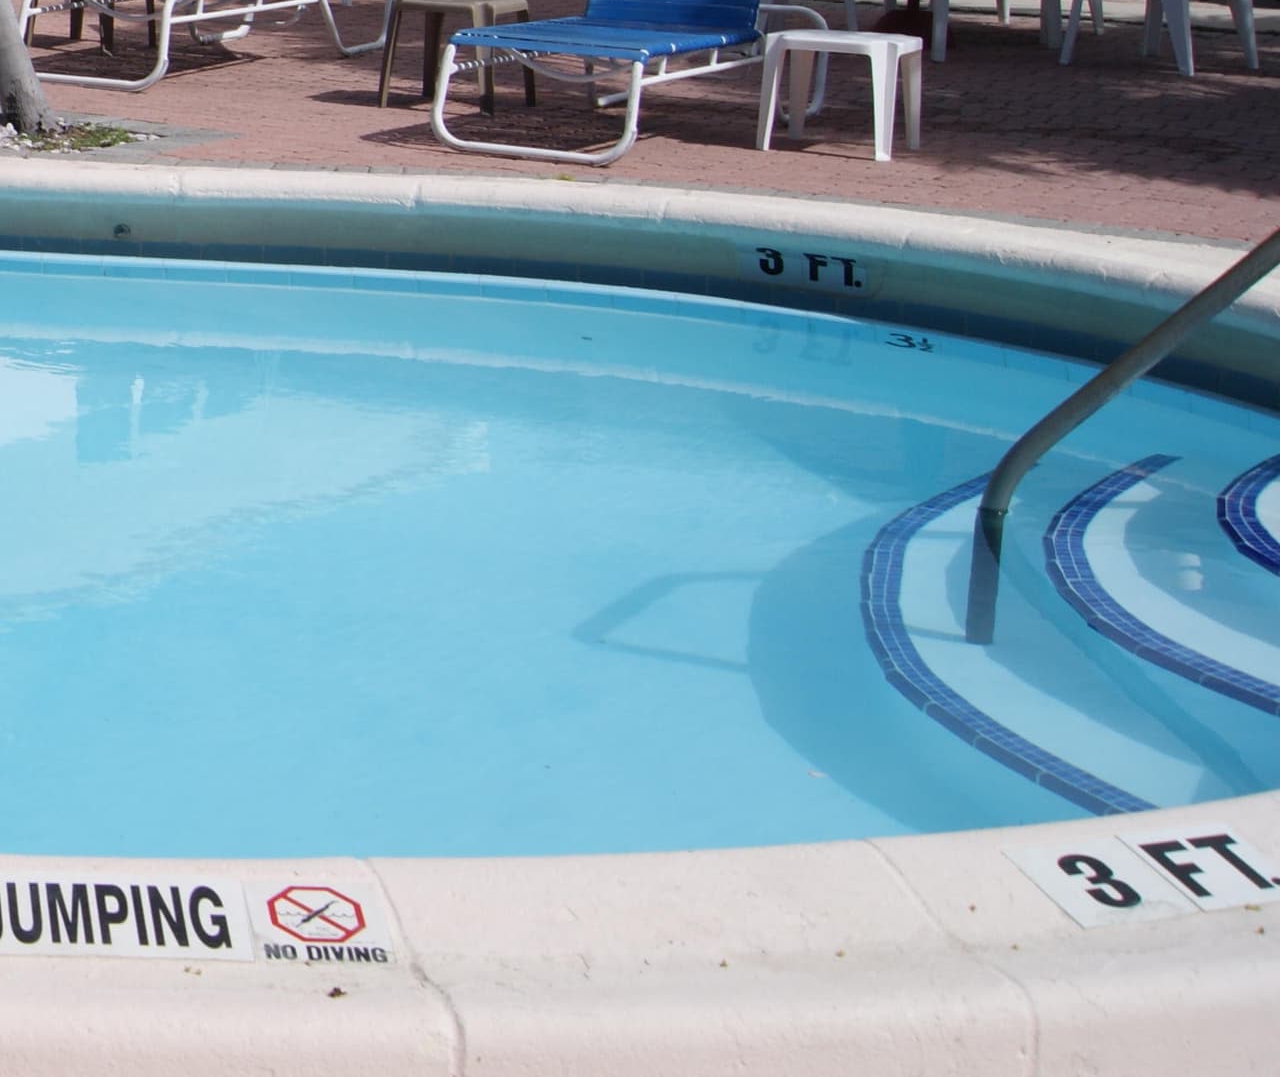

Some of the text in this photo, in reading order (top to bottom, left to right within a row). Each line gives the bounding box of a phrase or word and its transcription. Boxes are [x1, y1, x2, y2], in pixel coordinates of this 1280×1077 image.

[756, 247, 862, 288] 3 FT.
[1057, 854, 1142, 908] 3
[264, 944, 388, 963] NO DIVING
